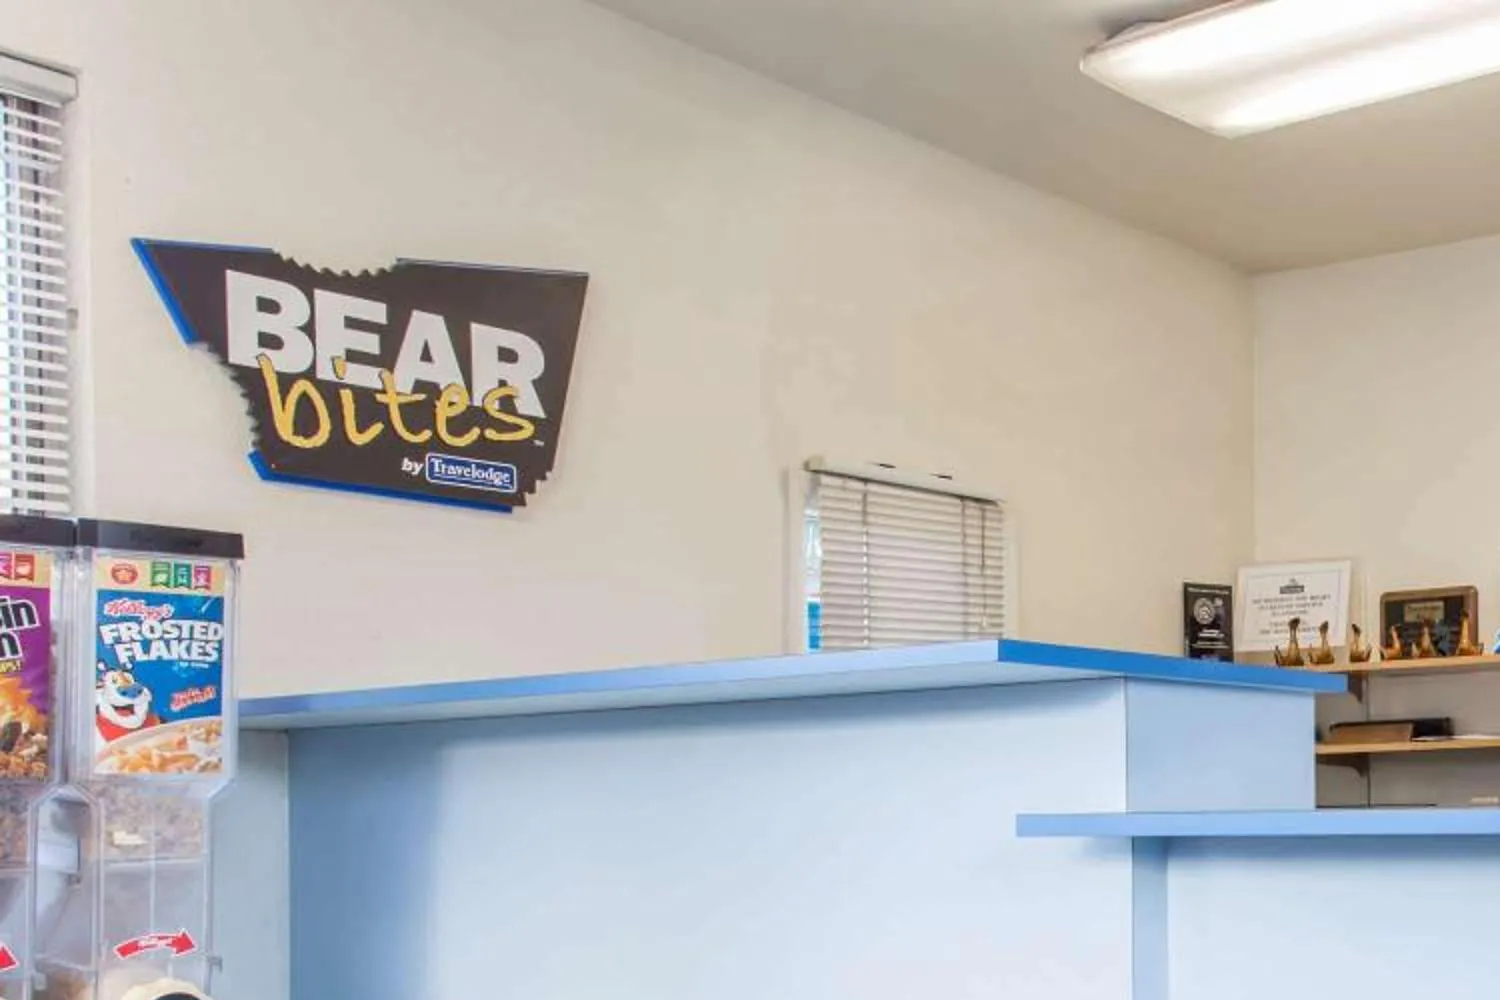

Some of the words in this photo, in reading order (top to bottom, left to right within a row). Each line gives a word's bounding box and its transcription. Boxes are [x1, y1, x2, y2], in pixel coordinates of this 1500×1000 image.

[225, 268, 547, 418] BEAR
[256, 352, 537, 448] bites
[401, 457, 424, 476] by
[430, 458, 511, 487] Travelodge
[99, 619, 225, 646] FROSTED
[114, 639, 219, 666] FLAKES
